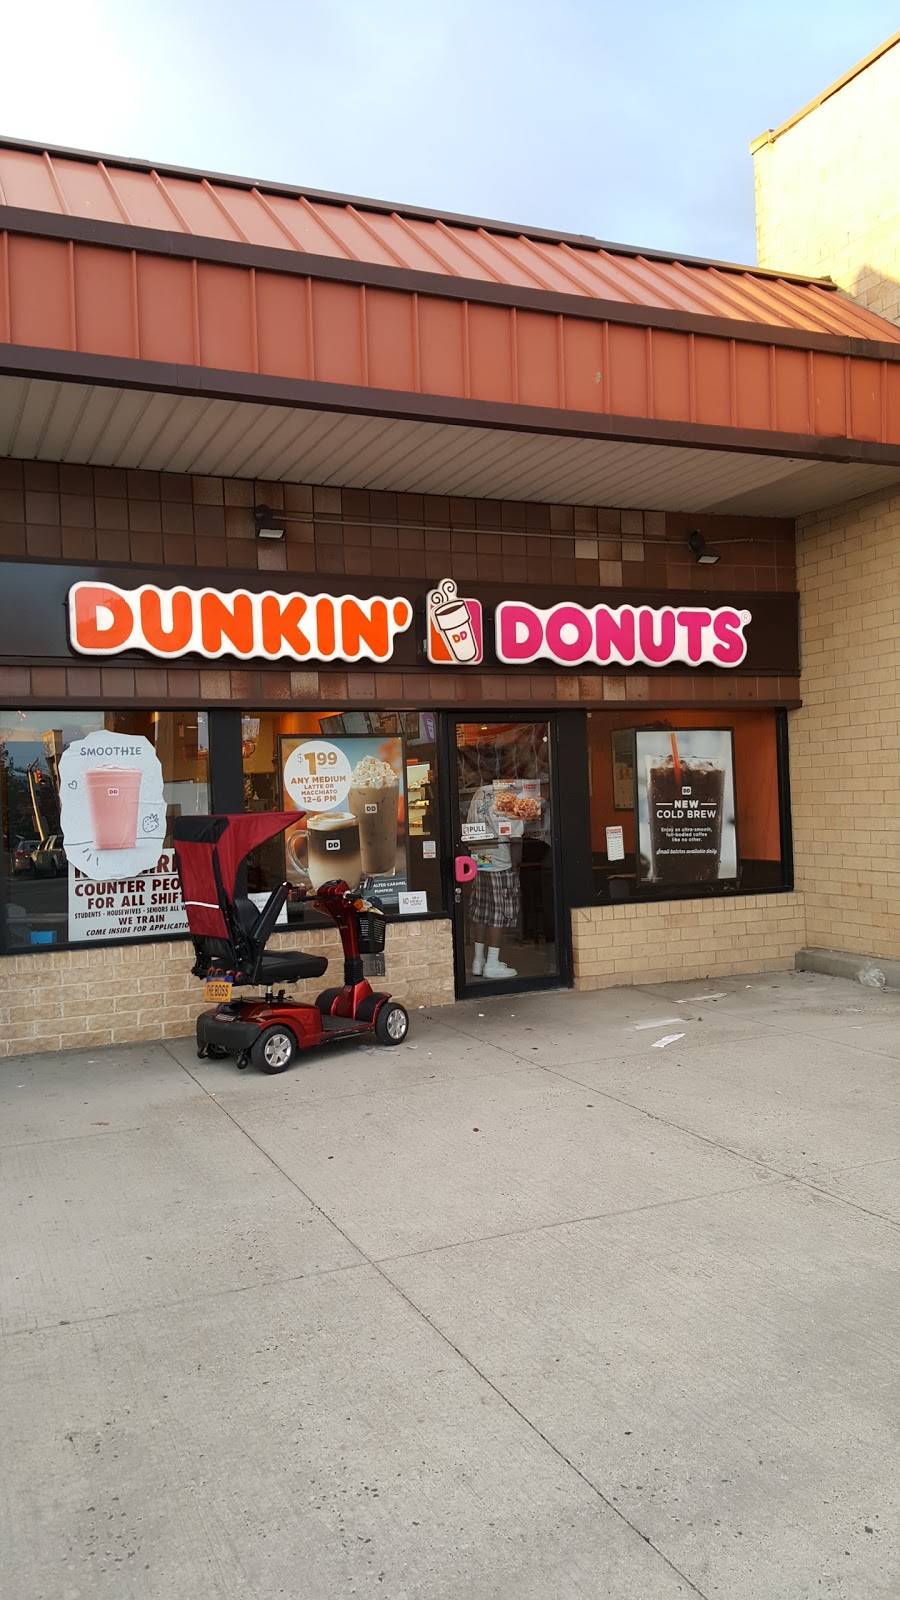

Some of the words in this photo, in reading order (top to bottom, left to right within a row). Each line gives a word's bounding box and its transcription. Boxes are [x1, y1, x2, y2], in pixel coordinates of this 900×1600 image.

[73, 586, 408, 657] DUNKIN'
[500, 605, 744, 663] DONUTS
[452, 631, 467, 643] DD
[80, 746, 142, 756] SMOOTHIE
[312, 775, 346, 783] MEDIUM
[674, 800, 699, 808] NEW
[656, 810, 684, 818] COLD
[687, 810, 717, 818] BREW
[470, 825, 485, 833] PULL
[455, 855, 477, 882] D
[75, 880, 145, 896] COUNTER
[152, 878, 181, 891] PEO
[87, 897, 114, 909] FOR
[121, 895, 145, 908] ALL
[151, 892, 182, 905] SHIF
[74, 911, 101, 919] STUDENTS
[107, 908, 141, 917] HOUSEWIVES
[146, 906, 168, 914] SENIORS
[118, 917, 133, 925] WE
[137, 914, 165, 924] TRAIN
[86, 929, 107, 937] COME
[108, 926, 130, 935] INSIDE
[133, 924, 147, 933] FOR
[149, 921, 189, 931] APPLICATIO
